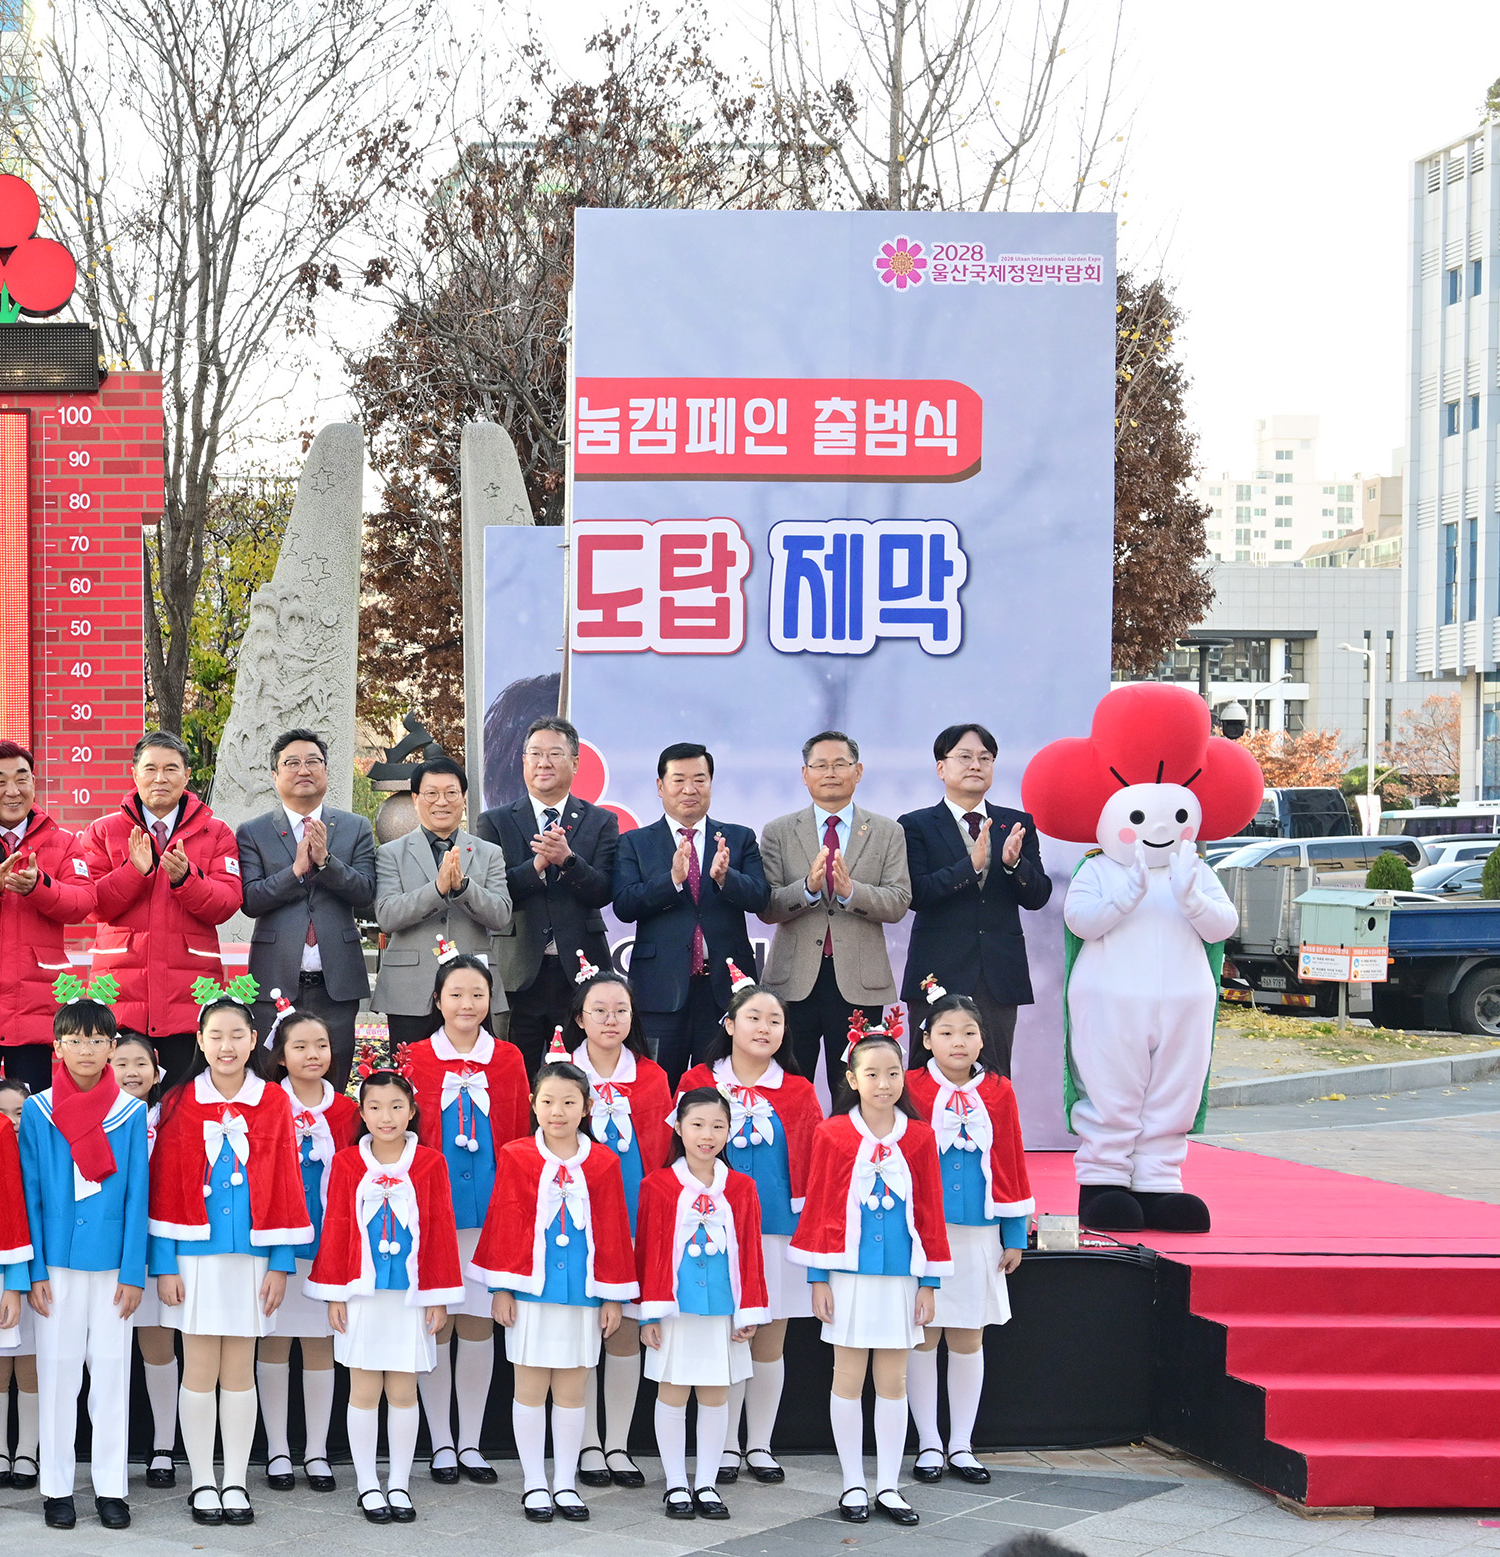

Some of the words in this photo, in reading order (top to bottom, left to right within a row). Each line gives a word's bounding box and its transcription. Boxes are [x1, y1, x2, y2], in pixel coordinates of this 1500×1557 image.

[932, 244, 984, 262] 2028
[931, 263, 1102, 283] 울산국제정원박람회
[57, 406, 92, 425] 100
[577, 396, 788, 456] 눔캠페인
[813, 396, 958, 457] 출범식
[68, 450, 90, 467] 90
[69, 493, 90, 510] 80
[69, 535, 90, 552] 70
[69, 577, 91, 594] 60
[575, 528, 741, 644] 도탑
[779, 530, 957, 645] 제막
[70, 619, 92, 636] 50
[70, 662, 92, 678] 40
[71, 704, 92, 721] 30
[71, 746, 92, 763] 20
[71, 788, 90, 805] 10
